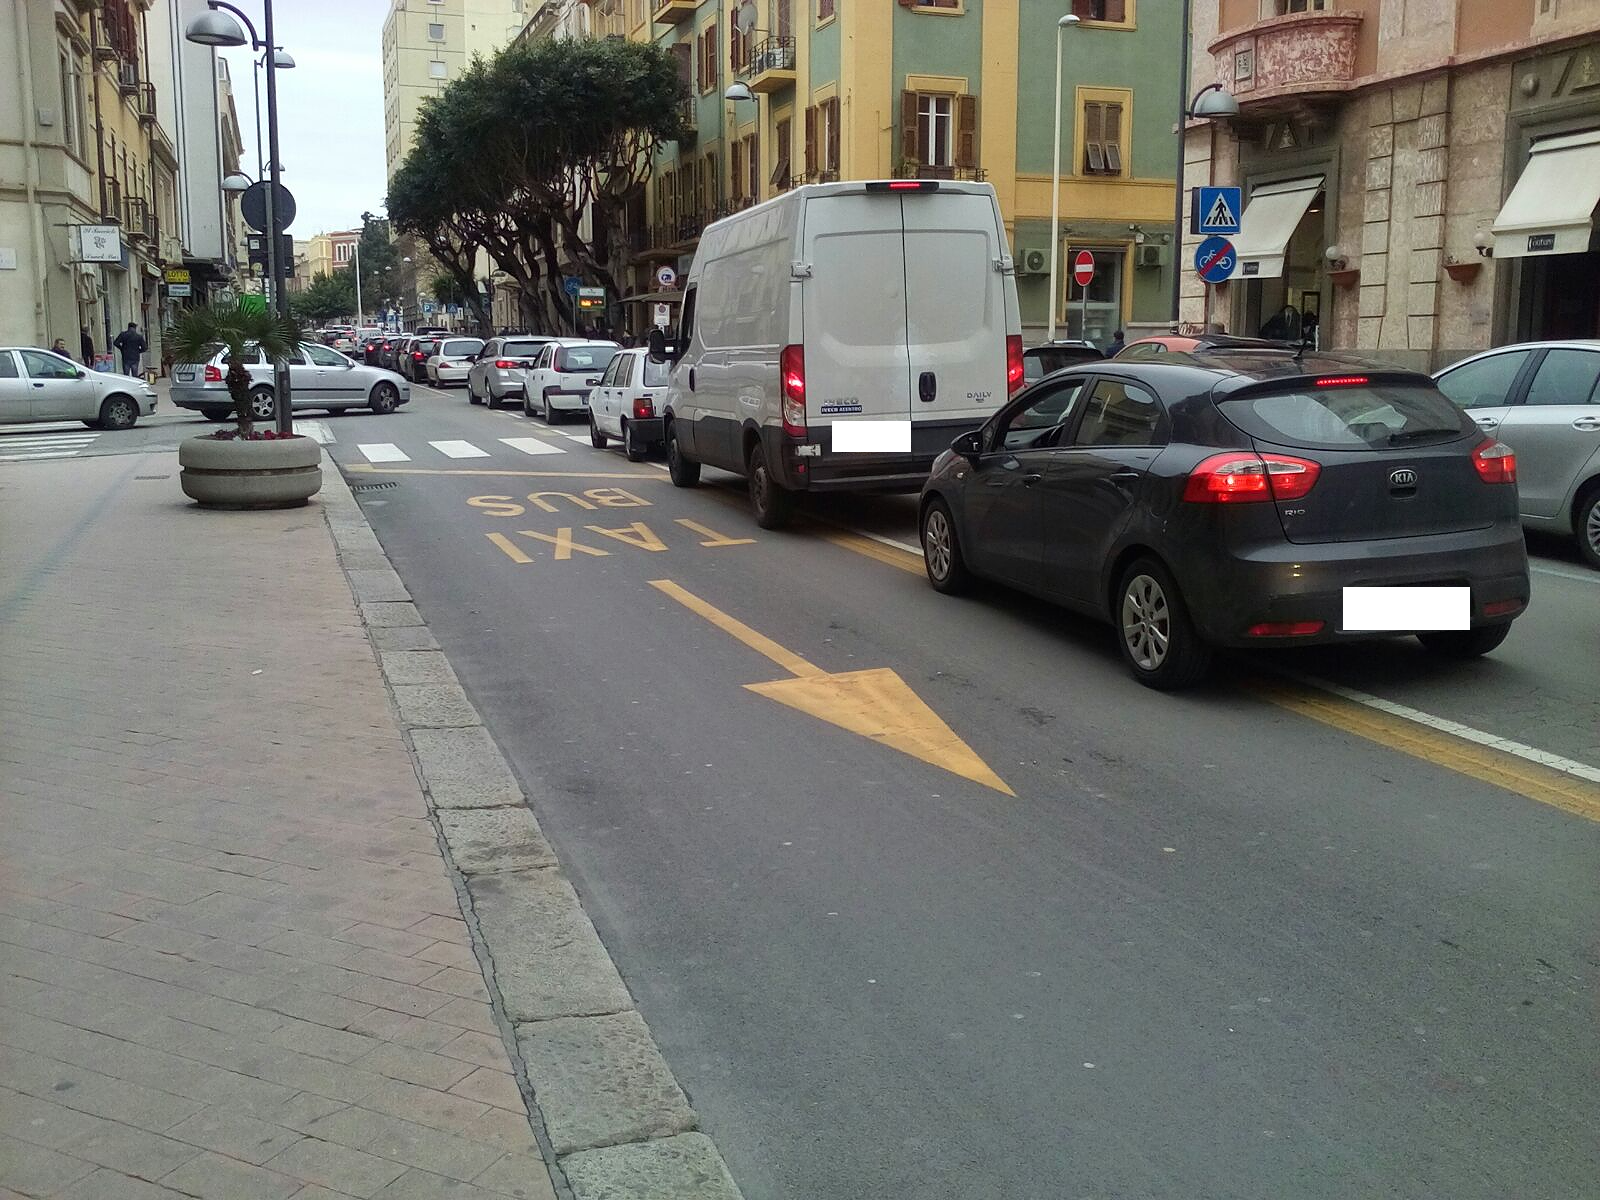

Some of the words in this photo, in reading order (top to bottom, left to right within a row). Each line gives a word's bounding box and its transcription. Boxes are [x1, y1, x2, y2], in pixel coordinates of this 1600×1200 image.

[966, 391, 992, 399] DAILY
[1394, 472, 1414, 484] KIA
[466, 488, 655, 517] BUS
[1284, 509, 1306, 517] RIO
[484, 518, 757, 564] TAXI
